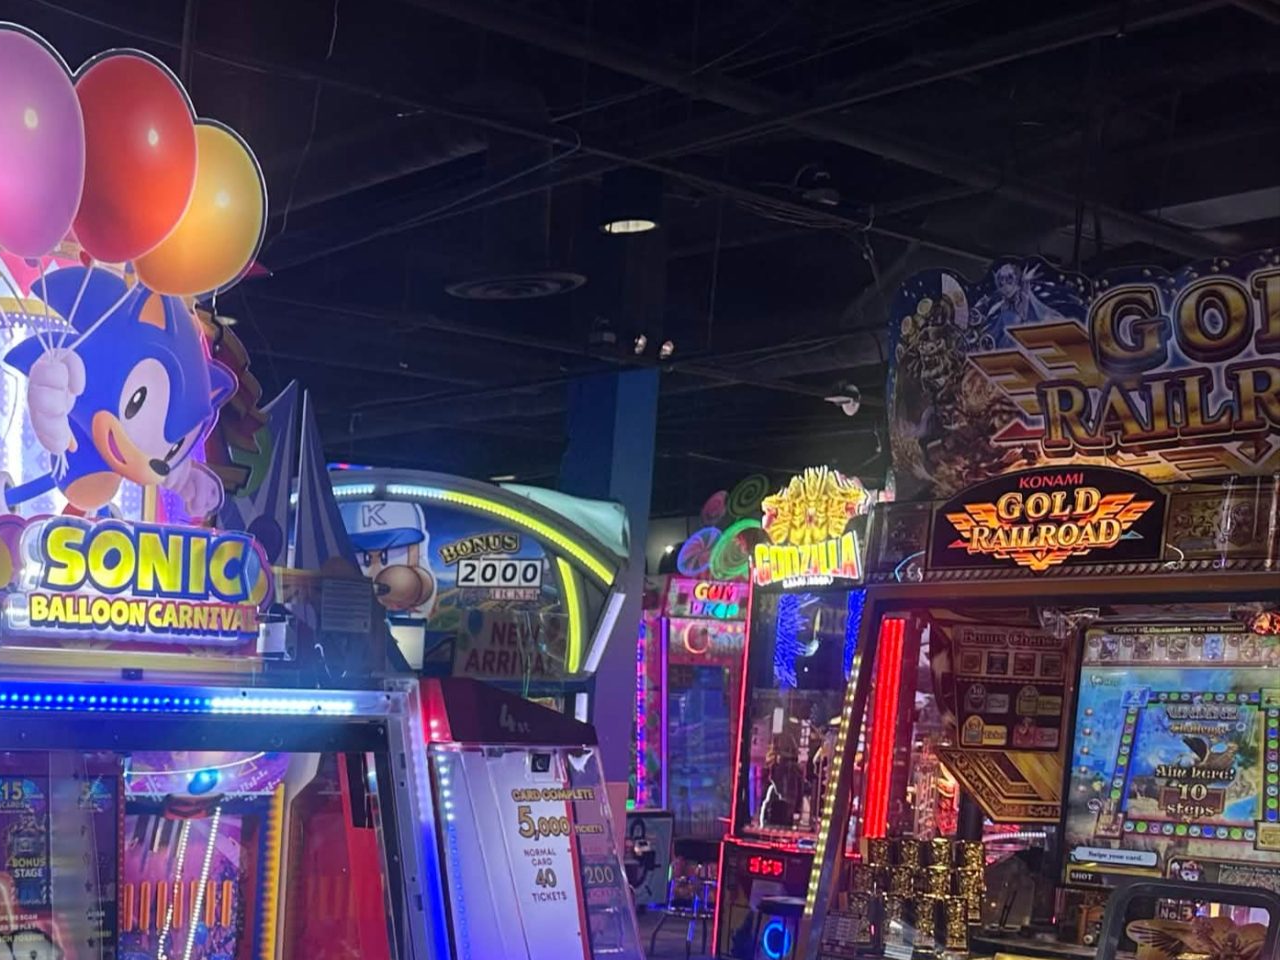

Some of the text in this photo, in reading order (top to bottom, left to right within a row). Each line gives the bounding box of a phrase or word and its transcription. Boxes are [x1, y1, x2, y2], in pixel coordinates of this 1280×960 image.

[1019, 473, 1084, 489] KONAMI
[997, 487, 1101, 521] GOLD
[361, 502, 387, 527] K
[970, 518, 1122, 551] RAILROAD
[439, 533, 519, 564] BONUS
[754, 530, 862, 586] GODZILLA
[42, 521, 248, 600] SONIC
[460, 562, 539, 584] 2000
[695, 582, 739, 600] GUM
[30, 594, 259, 635] BALLOON CARNIVAL
[690, 601, 740, 618] DROP
[491, 622, 543, 646] NEW
[499, 704, 515, 732] 4
[1156, 765, 1186, 778] Aim
[511, 787, 596, 802] CARD COMPLETE
[1178, 783, 1208, 801] 10
[1167, 802, 1215, 818] steps
[517, 805, 604, 841] 5,000 TICKETS
[524, 848, 557, 858] NORMAL
[531, 857, 553, 867] CARD
[14, 868, 43, 879] STAGE
[535, 868, 557, 888] 40
[584, 865, 615, 885] 200
[1070, 872, 1094, 883] SHOT
[531, 890, 568, 902] TICKETS
